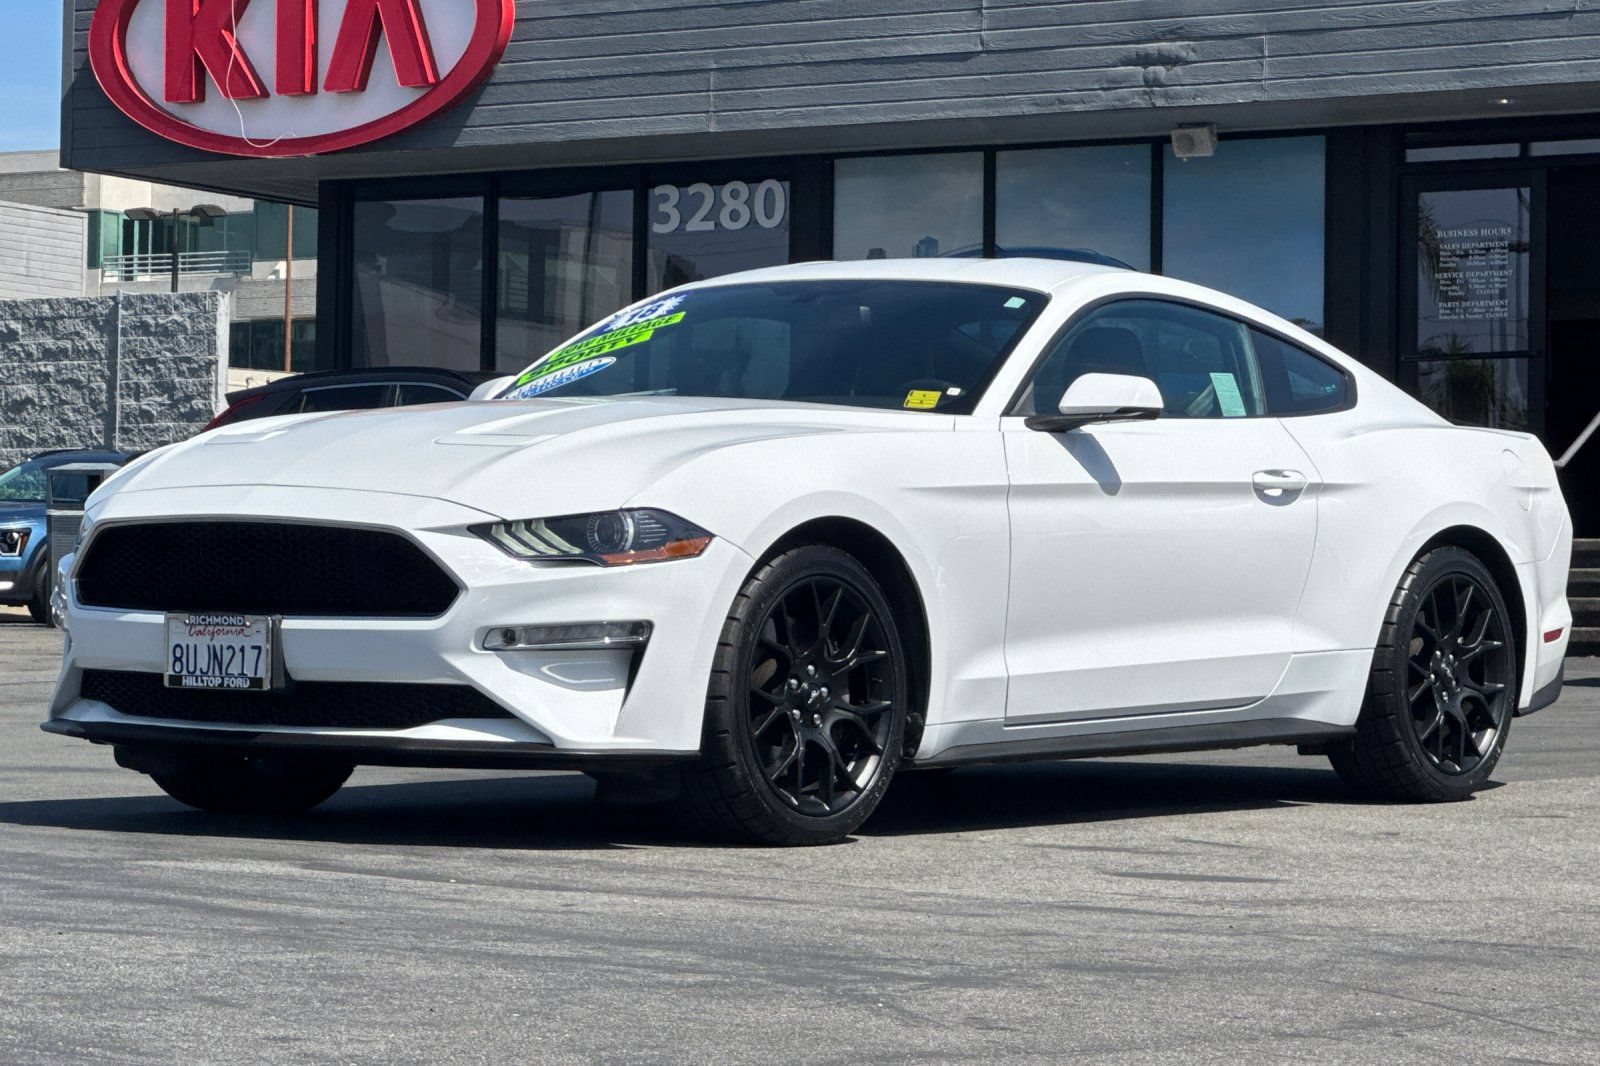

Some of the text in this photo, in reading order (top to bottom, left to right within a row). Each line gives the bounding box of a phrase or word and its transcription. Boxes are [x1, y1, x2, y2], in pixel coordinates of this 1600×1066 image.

[163, 0, 440, 103] KIA
[652, 179, 785, 233] 3280
[1437, 227, 1512, 238] BUSINESS HOURS
[1439, 242, 1460, 250] SALES
[1435, 270, 1513, 279] SERVICE DEPARTMENT
[598, 315, 679, 342] MILEAGE
[528, 334, 642, 377] SPORTY
[189, 615, 244, 625] RICHMOND
[188, 625, 251, 641] California
[172, 643, 262, 677] 8UJN217
[182, 676, 250, 688] HILLTOP FORD
